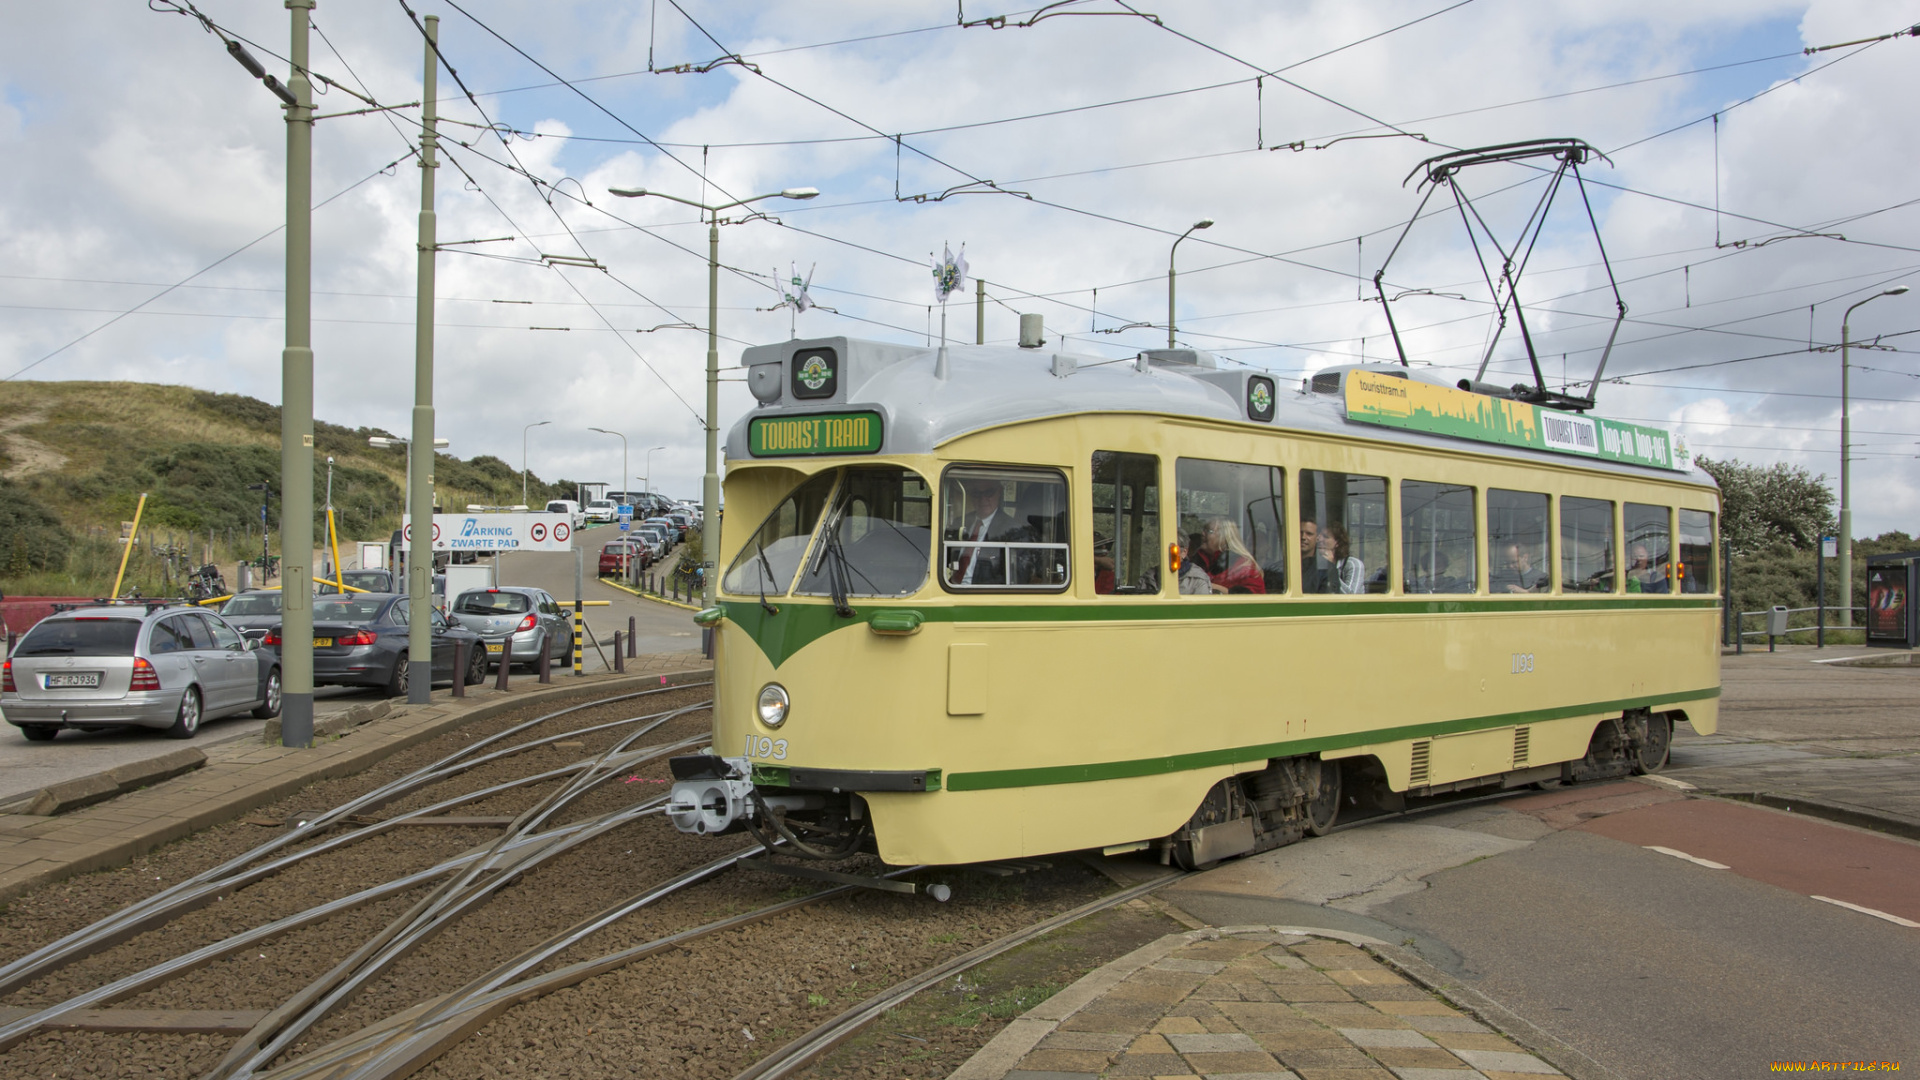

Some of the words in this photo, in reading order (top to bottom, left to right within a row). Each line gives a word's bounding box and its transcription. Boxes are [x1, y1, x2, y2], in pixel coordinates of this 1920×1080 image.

[1359, 379, 1407, 398] touristtram.nl
[760, 420, 821, 451] TOURIST
[824, 417, 870, 448] TRAM
[1543, 416, 1574, 444] TOURIST
[1573, 421, 1595, 448] TRAM
[1600, 421, 1634, 458] hop-on
[1634, 427, 1667, 465] hop-off
[460, 518, 513, 537] PARKING
[451, 539, 494, 548] ZWARTE
[498, 539, 519, 548] PAD
[1511, 653, 1534, 674] 1193
[743, 734, 789, 760] 1193
